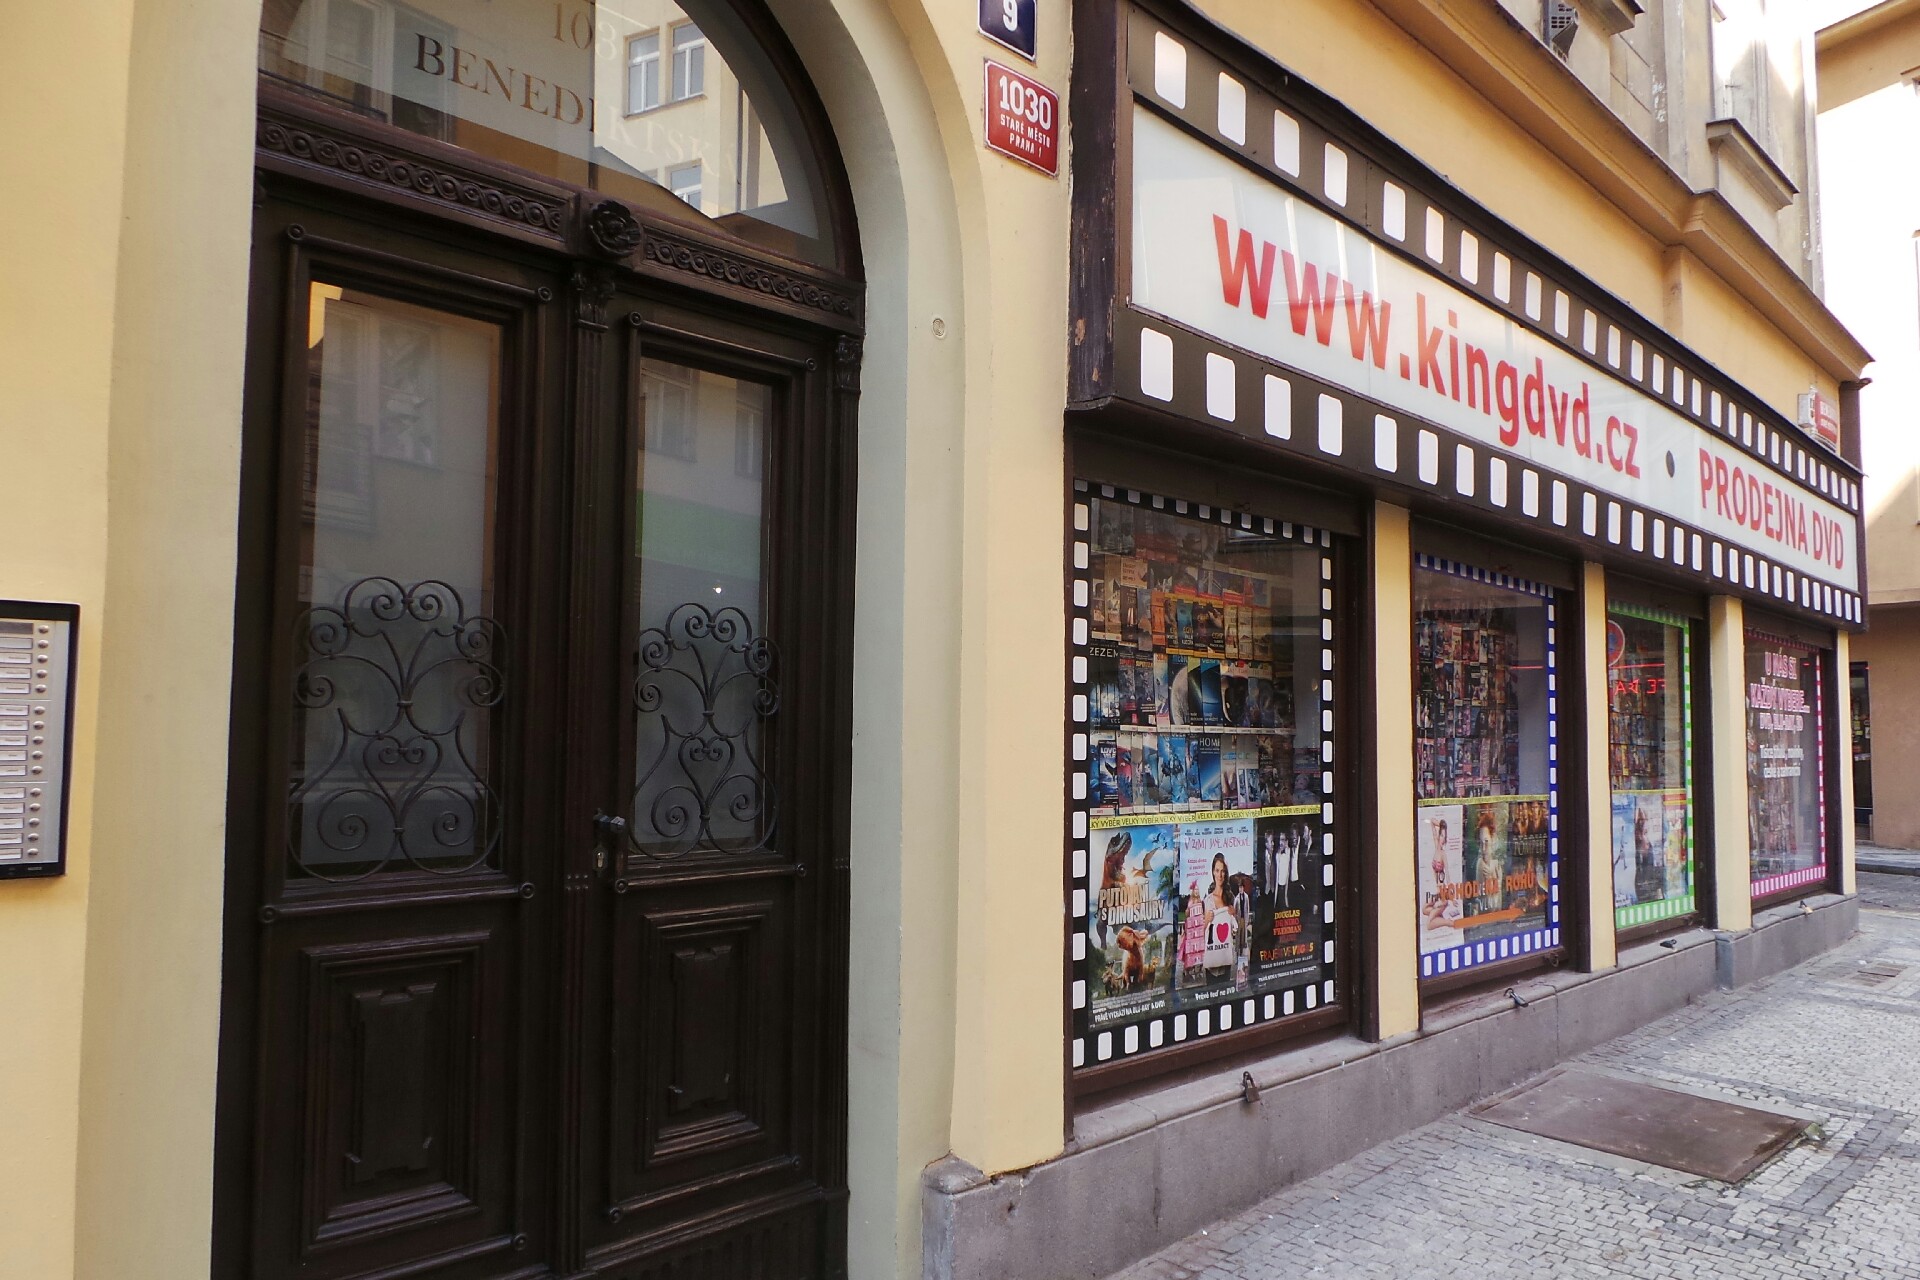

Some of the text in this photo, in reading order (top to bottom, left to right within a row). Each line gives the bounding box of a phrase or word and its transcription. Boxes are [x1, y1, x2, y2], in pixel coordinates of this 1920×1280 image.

[1002, 0, 1018, 32] 9
[1000, 75, 1051, 131] 1030
[1000, 113, 1024, 134] STARÉ
[1213, 213, 1640, 479] www.kingdvd.cz
[1699, 447, 1844, 570] PRODEJNA DVD
[1108, 900, 1165, 926] DINOSAURY
[1274, 910, 1300, 920] DOUGLAS
[1207, 923, 1214, 945] I
